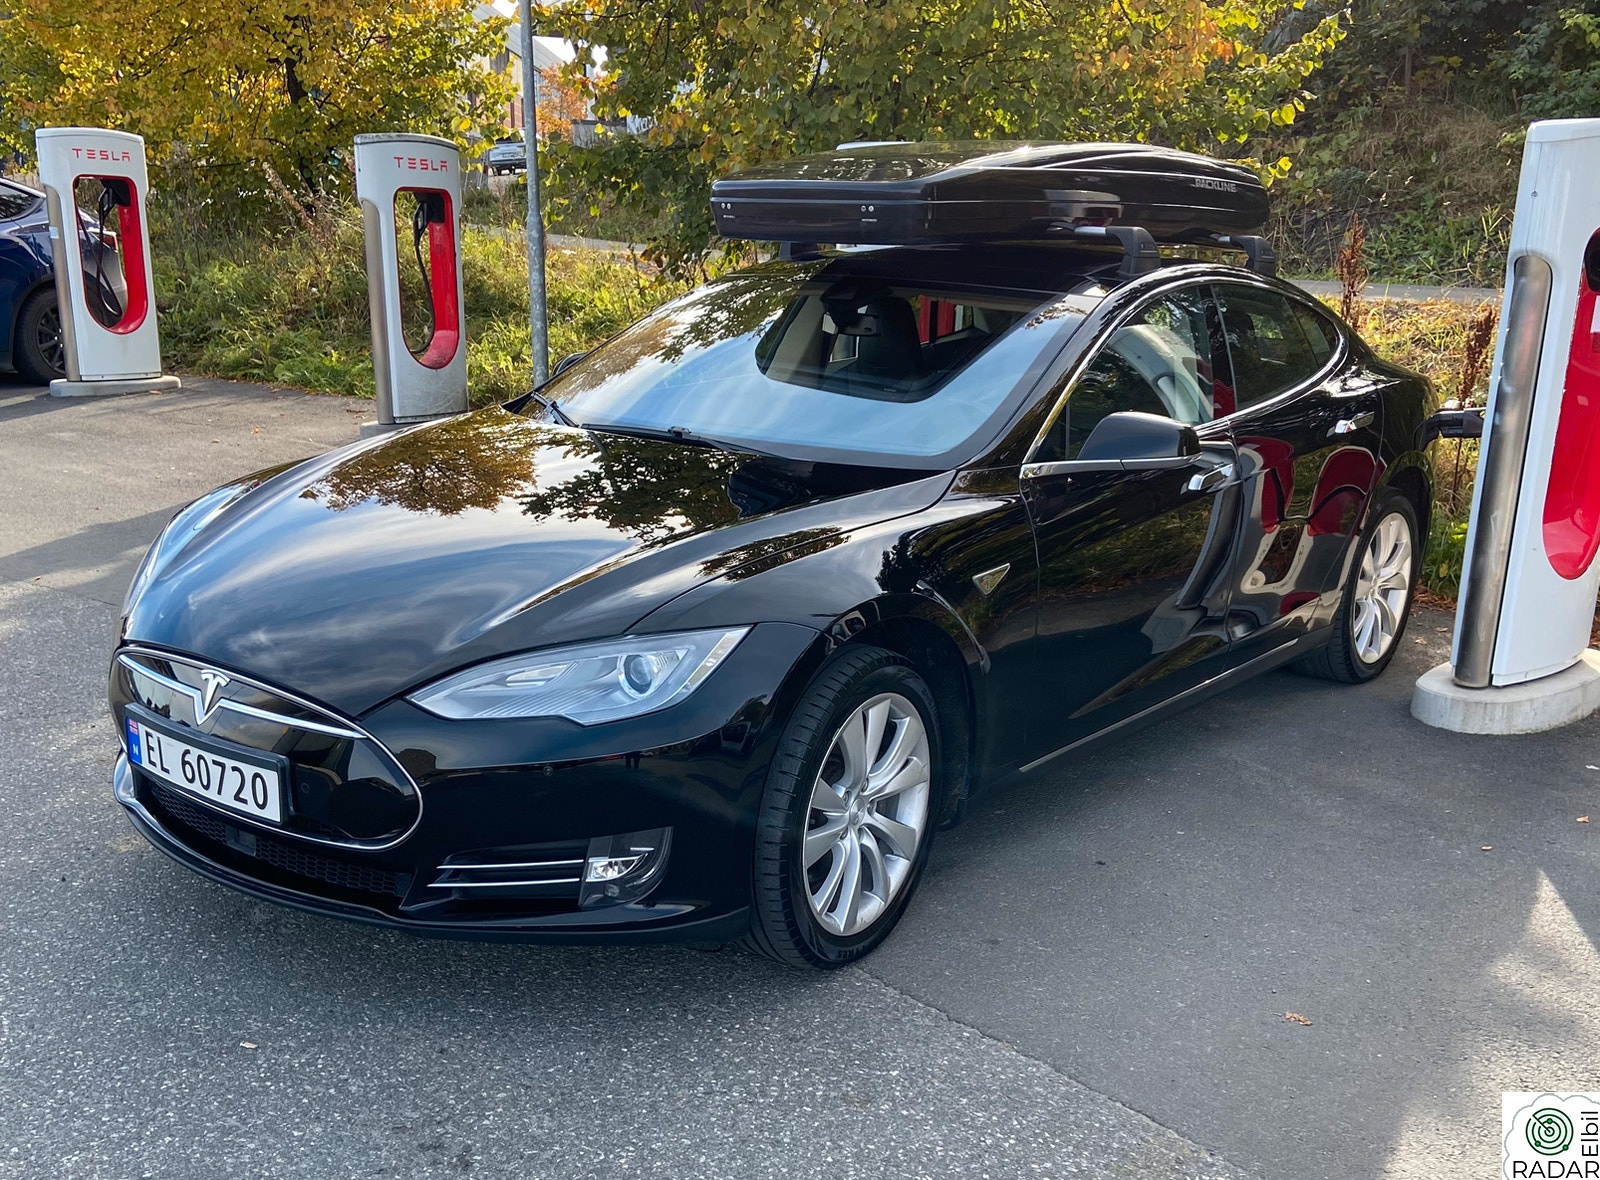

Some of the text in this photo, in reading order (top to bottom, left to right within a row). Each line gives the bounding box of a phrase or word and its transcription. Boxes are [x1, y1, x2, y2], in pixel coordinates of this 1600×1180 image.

[72, 148, 130, 161] TESLA
[393, 156, 448, 171] TESLA
[145, 730, 268, 810] EL 60720
